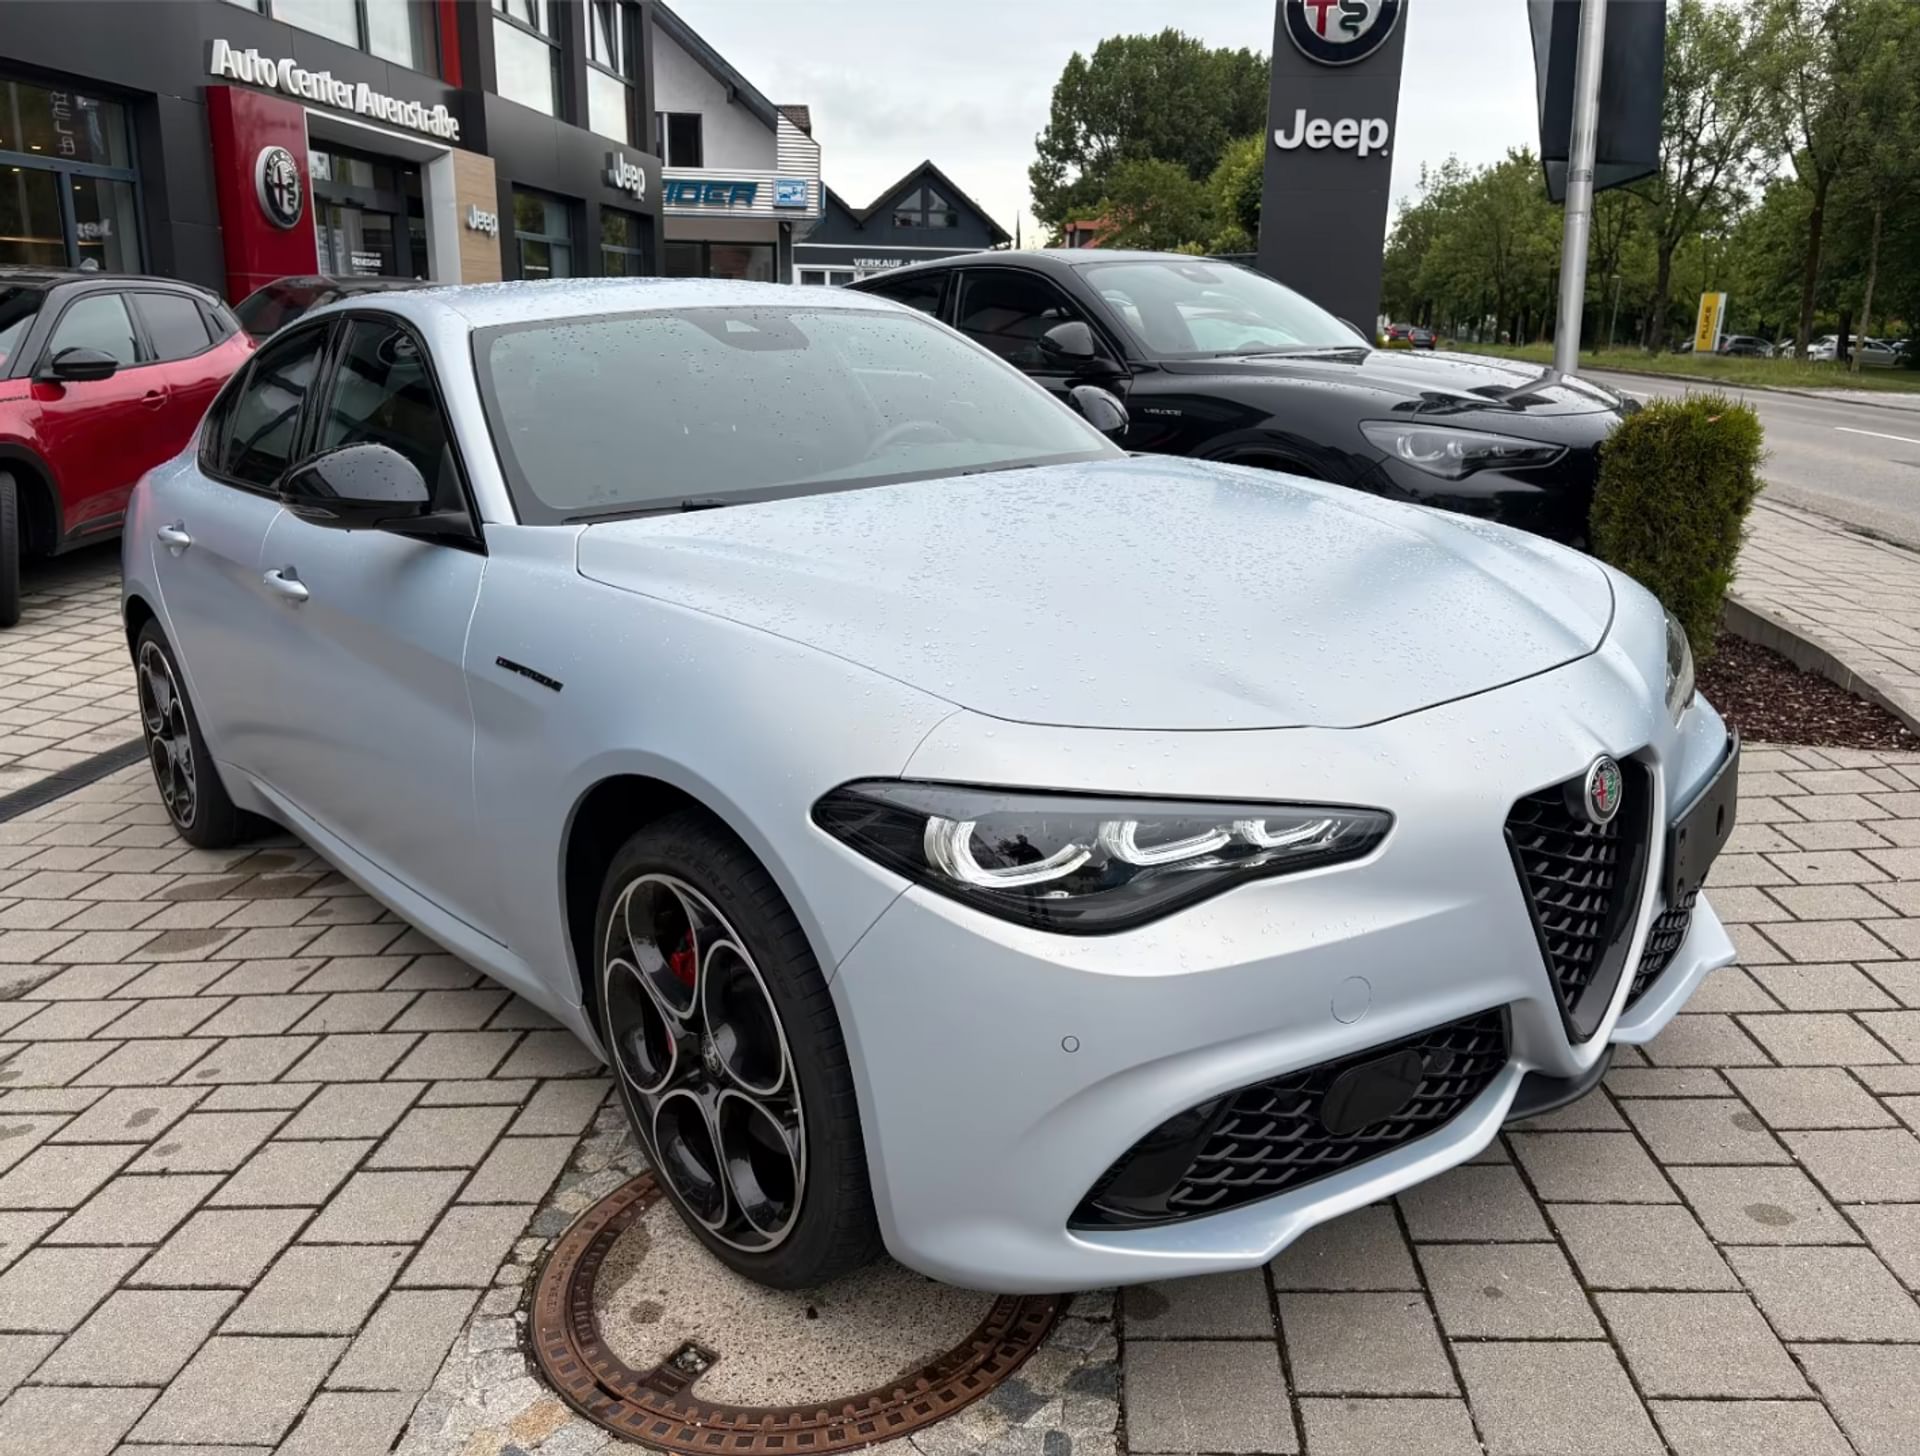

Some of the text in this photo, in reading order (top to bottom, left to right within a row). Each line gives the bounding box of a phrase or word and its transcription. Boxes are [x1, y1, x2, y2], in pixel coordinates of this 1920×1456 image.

[210, 39, 460, 141] Auto Center Auenstraße
[1274, 109, 1389, 157] Jeep
[614, 152, 646, 200] Jeep
[468, 204, 499, 237] Jeep
[853, 257, 903, 268] VERKAUF
